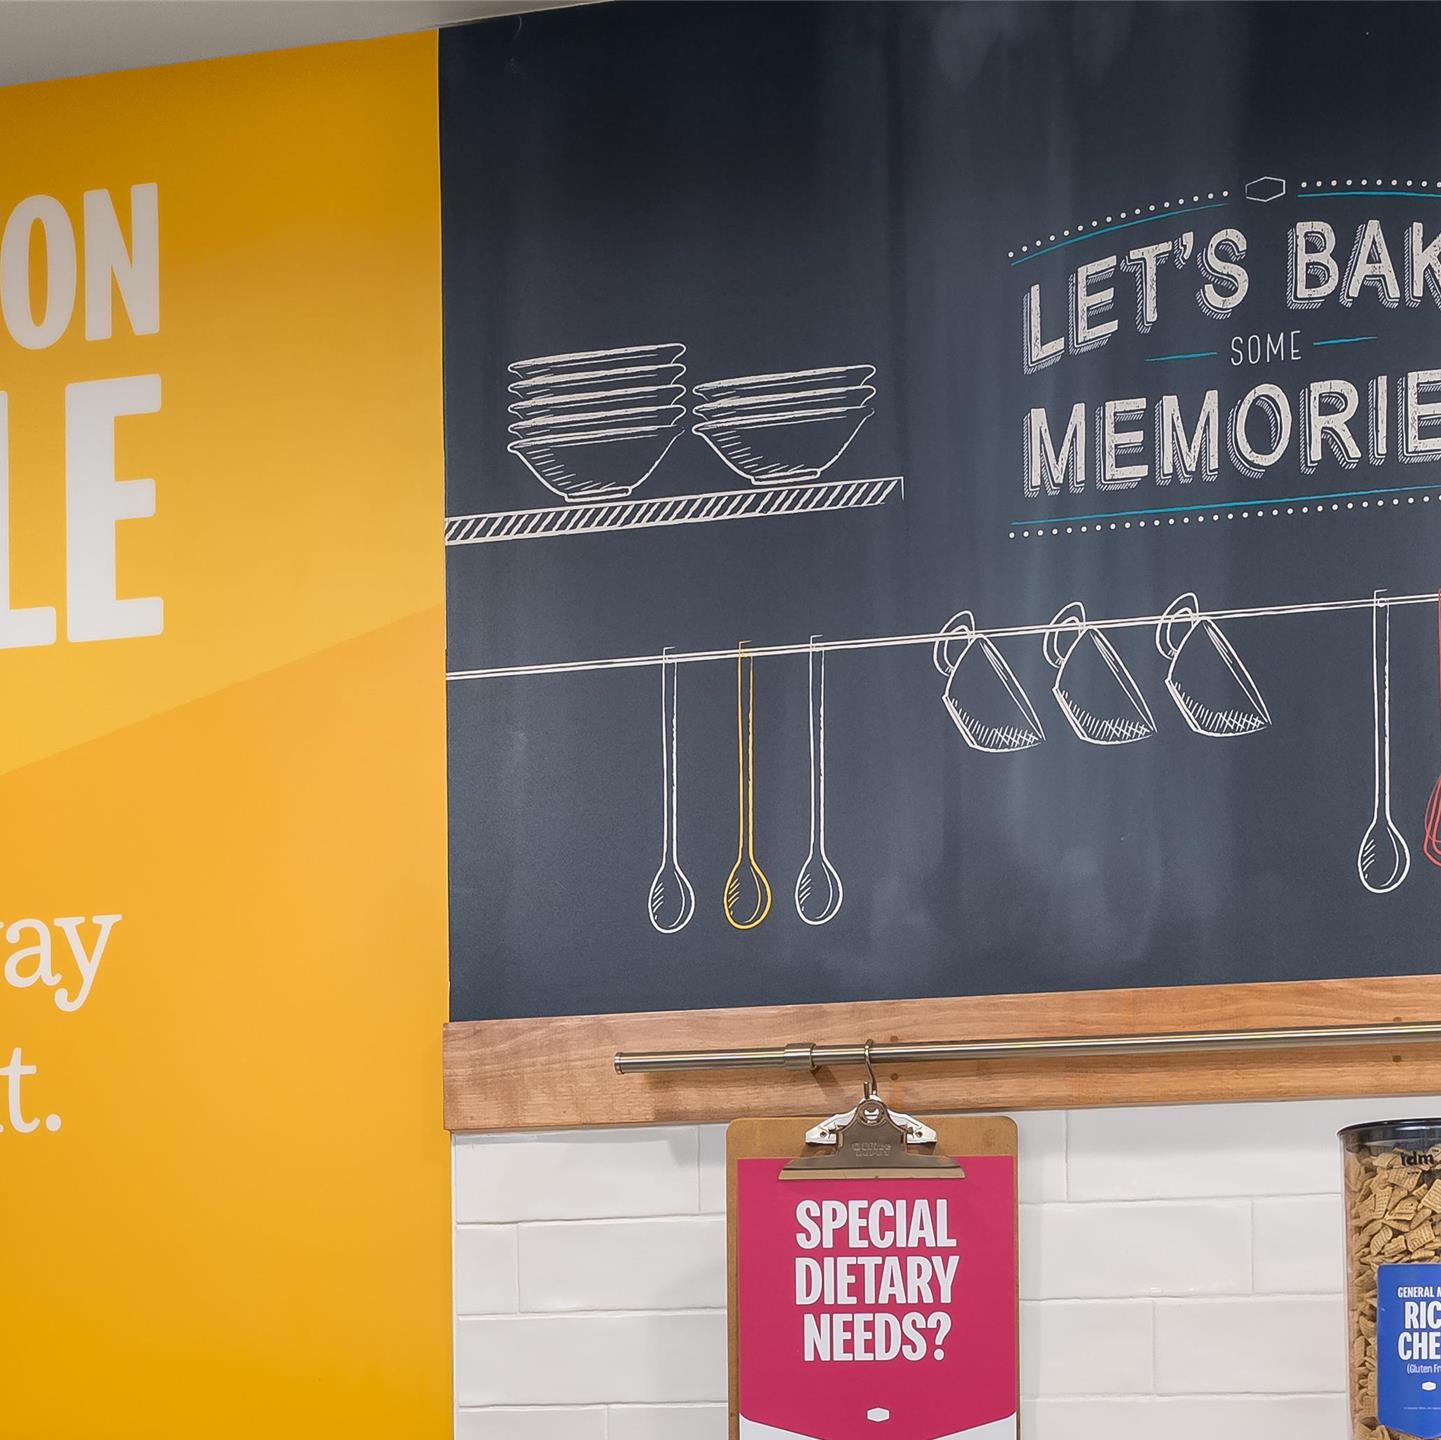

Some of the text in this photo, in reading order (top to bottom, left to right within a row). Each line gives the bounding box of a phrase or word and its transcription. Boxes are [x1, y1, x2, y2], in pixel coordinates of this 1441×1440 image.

[1023, 228, 1250, 375] LET'S
[1231, 330, 1303, 367] SOME
[795, 1199, 957, 1249] SPECIAL
[795, 1255, 960, 1305] DIETARY
[1398, 1286, 1435, 1298] GENERAL
[803, 1312, 952, 1362] NEEDS?
[1406, 1363, 1433, 1374] (Gluten
